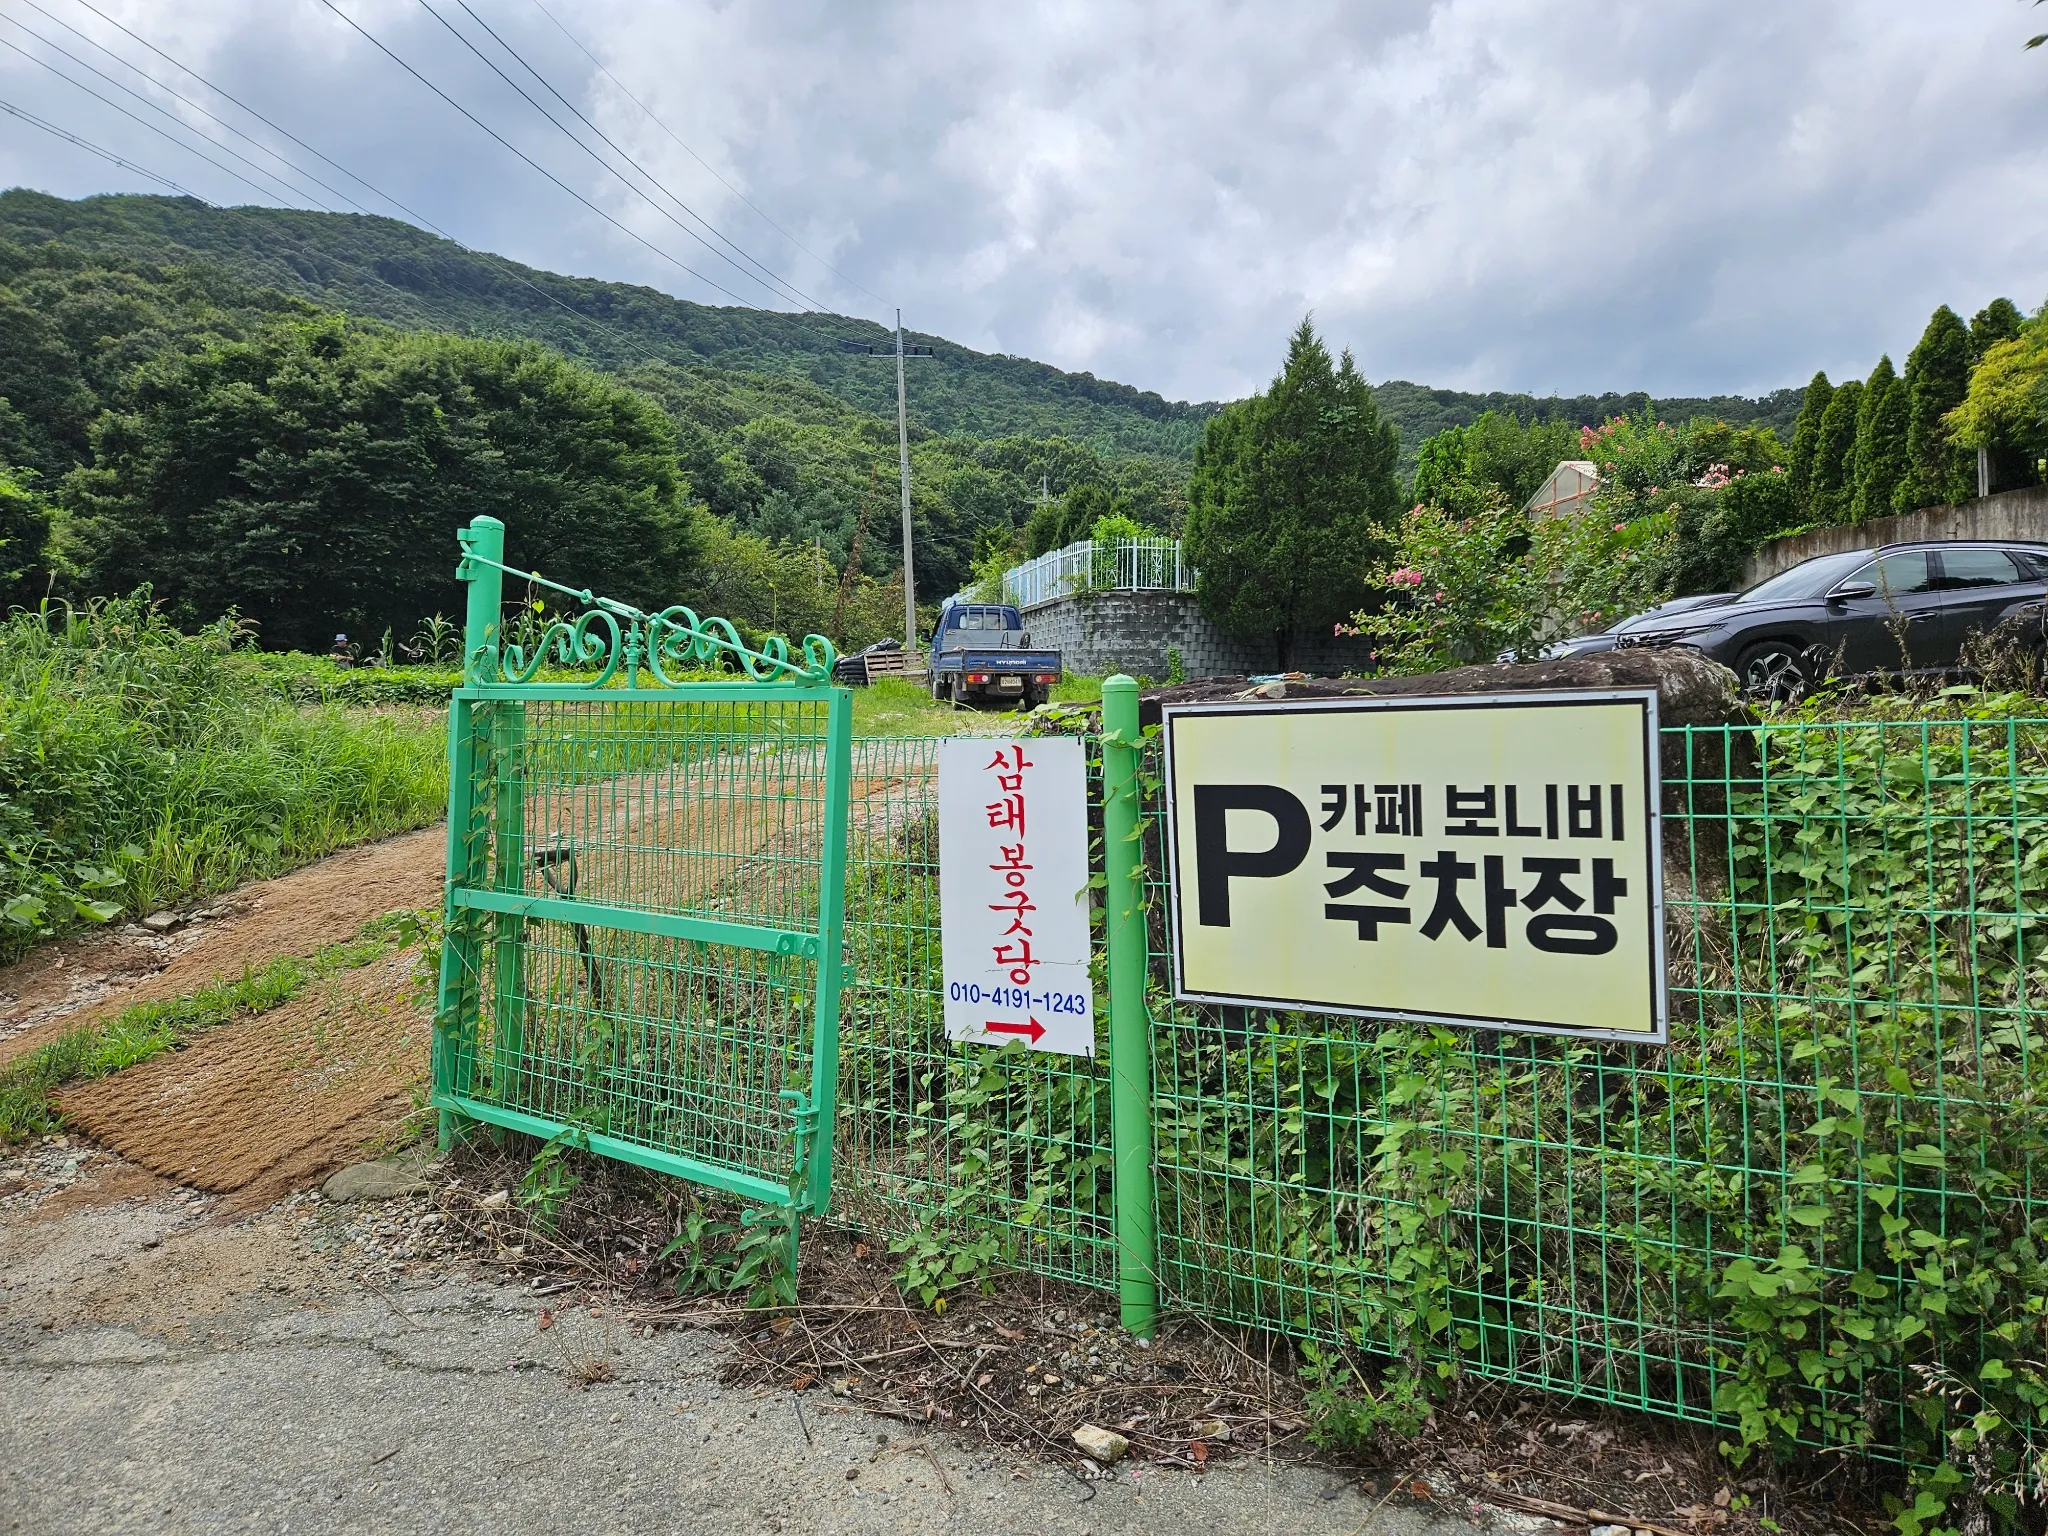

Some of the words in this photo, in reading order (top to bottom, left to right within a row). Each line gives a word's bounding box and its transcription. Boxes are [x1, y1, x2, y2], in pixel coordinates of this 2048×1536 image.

[983, 745, 1040, 985] 삼태봉굿당
[1193, 784, 1312, 928] P
[1319, 784, 1423, 837] 카페
[1444, 784, 1625, 842] 보니비
[1323, 851, 1628, 956] 주차장
[950, 982, 1086, 1015] 010-4191-1243
